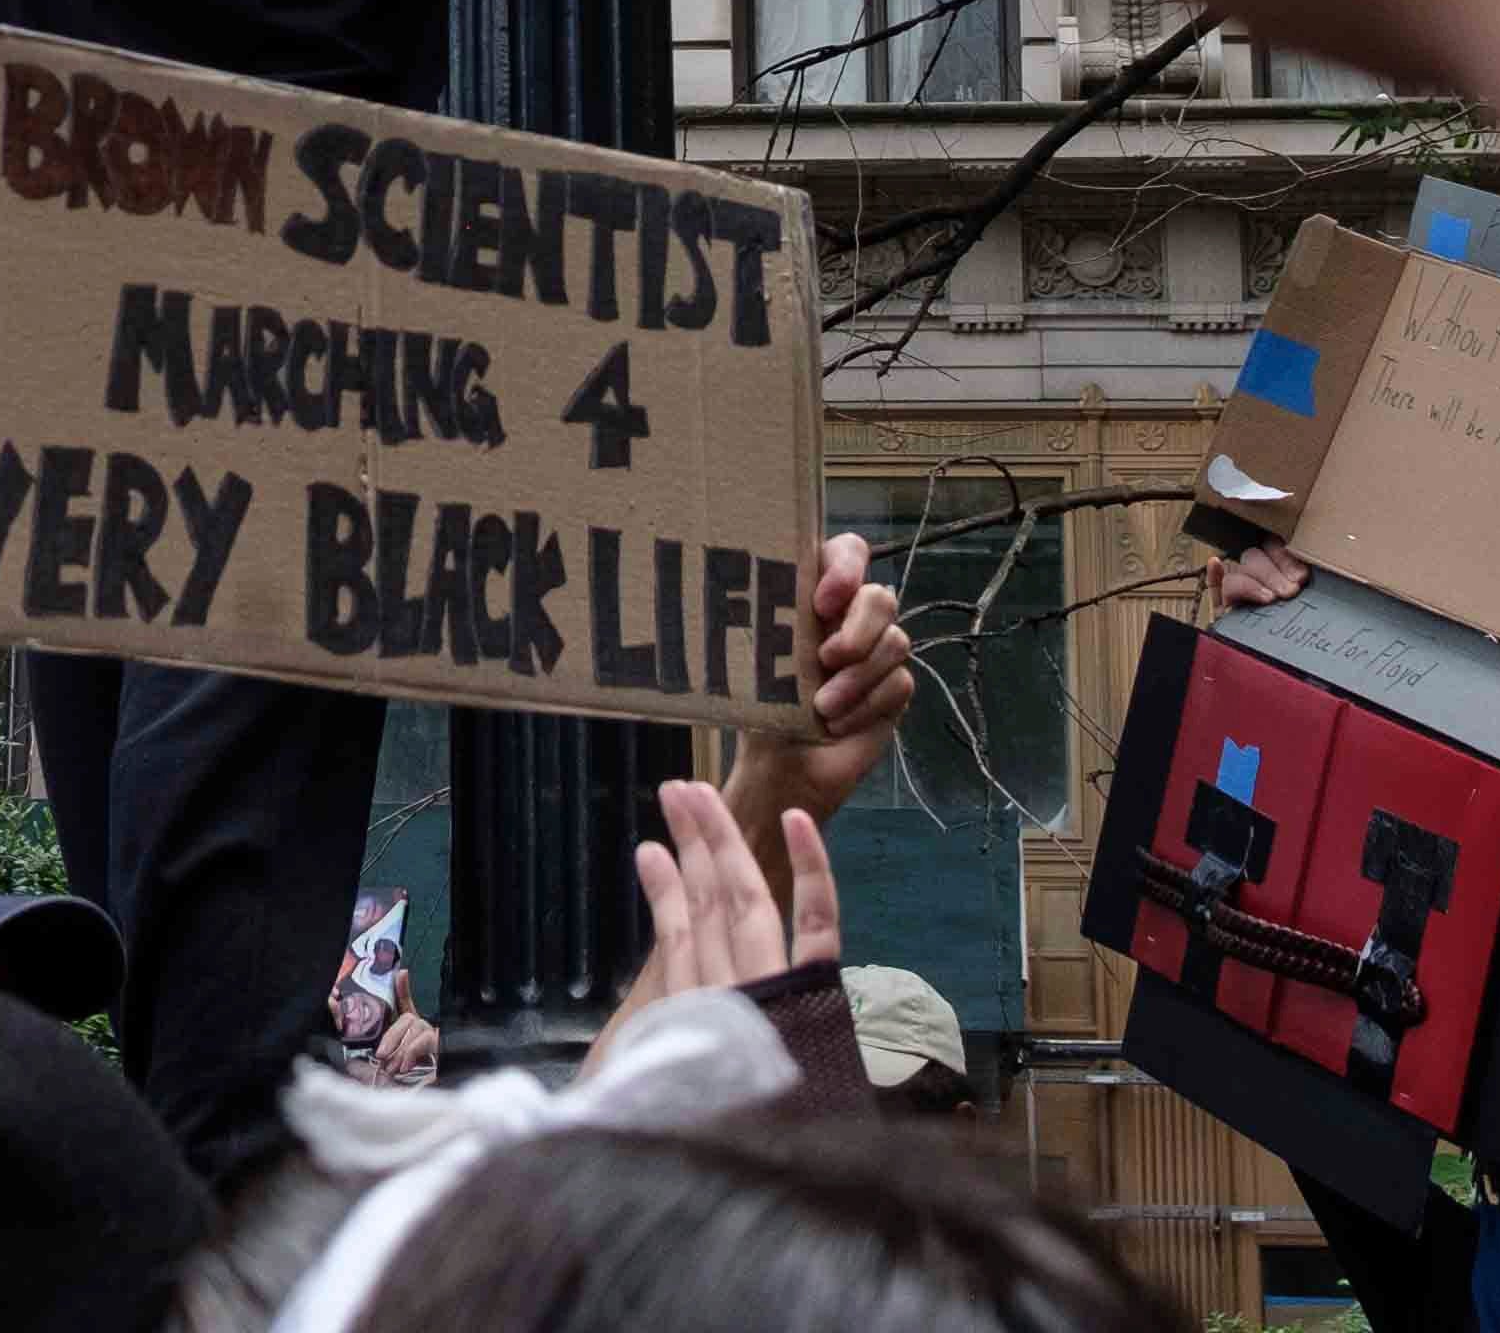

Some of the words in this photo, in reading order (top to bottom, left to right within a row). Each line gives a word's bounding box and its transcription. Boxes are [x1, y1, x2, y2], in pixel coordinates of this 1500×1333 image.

[3, 65, 273, 234] BROWN
[282, 125, 781, 346] SCIENTIST
[106, 284, 506, 450] MARCHING
[563, 342, 649, 469] 4
[305, 483, 565, 675] BLACK
[589, 527, 799, 703] LIFE
